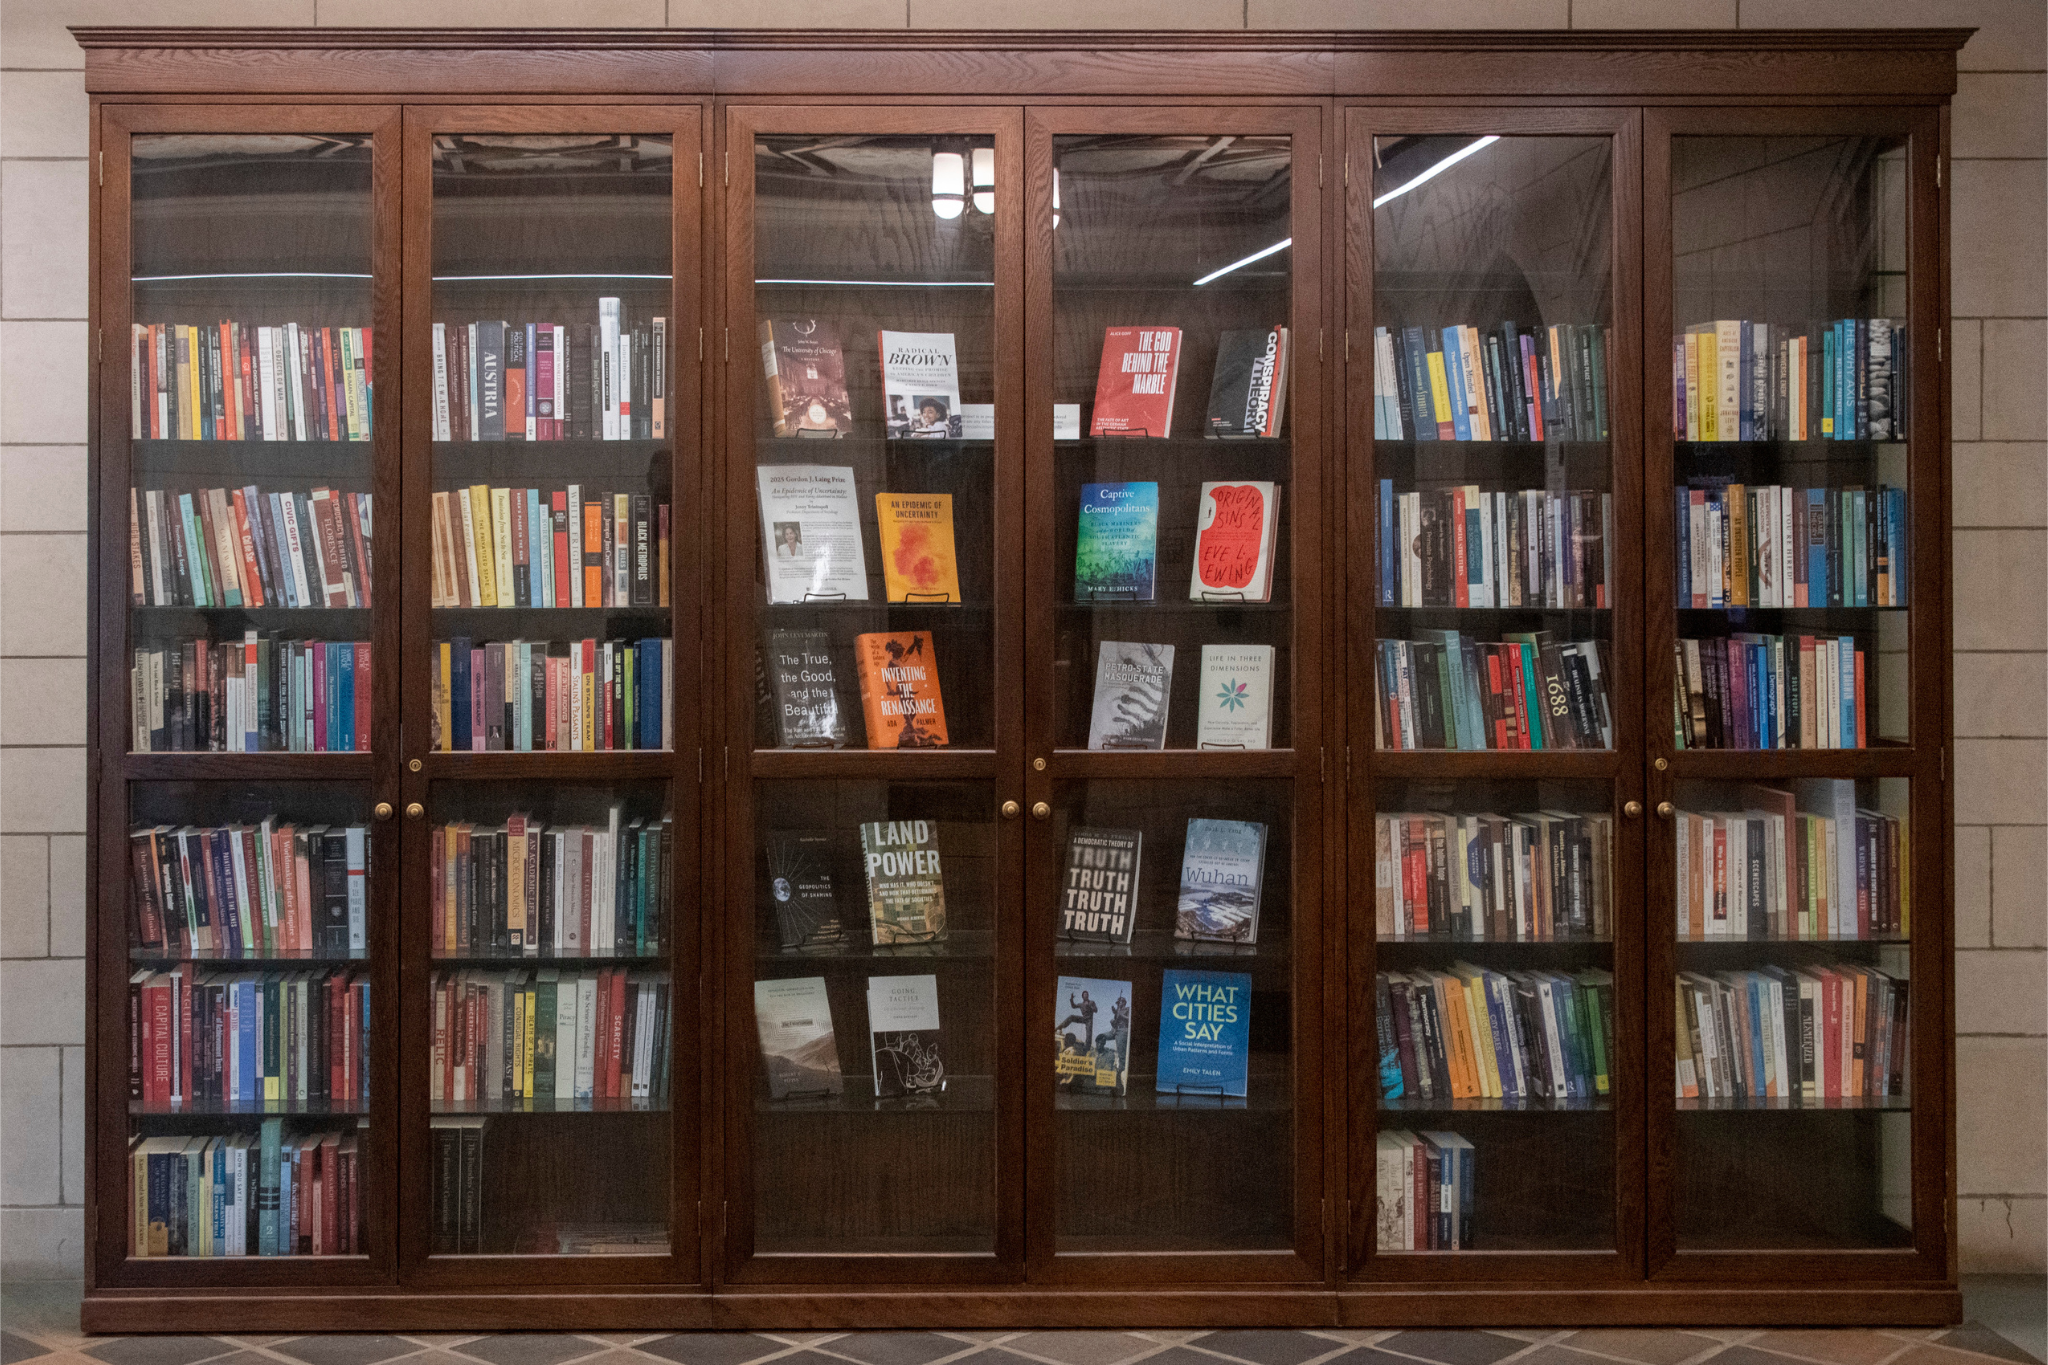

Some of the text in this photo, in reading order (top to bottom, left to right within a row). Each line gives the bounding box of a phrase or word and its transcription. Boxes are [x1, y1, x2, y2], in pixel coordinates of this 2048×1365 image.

[814, 347, 819, 355] of
[1138, 331, 1172, 352] THE GOD
[888, 353, 952, 366] BROWN
[1121, 353, 1169, 373] BEHIND THE
[277, 377, 283, 386] OF
[1255, 331, 1277, 432] CONSPIRACY
[1463, 352, 1475, 394] Open Minded
[484, 351, 497, 419] AUSTRIA
[1132, 374, 1166, 394] MARBLE
[891, 501, 941, 509] AN EPIDEMIC OF
[1100, 490, 1134, 501] Captive
[895, 510, 938, 519] UNCERTAINTY
[1084, 504, 1150, 516] Cosmopolitans
[1217, 510, 1245, 529] SINS
[284, 501, 299, 552] CIVIC GIFTS
[332, 499, 348, 569] DEMOCRACY REMIXED
[130, 522, 141, 569] HIGH STAKES
[175, 525, 184, 557] Provincializing
[324, 518, 338, 565] FLORENCE
[637, 521, 648, 580] BLACK METROPOLIS
[571, 532, 580, 572] FRIGHT
[1204, 544, 1245, 561] EVE L.
[1205, 558, 1254, 583] EWING
[1425, 558, 1433, 590] Psychology
[780, 653, 832, 665] The True,
[1105, 663, 1164, 674] PETRO-STATE
[137, 675, 145, 694] DAVIS
[781, 670, 836, 683] the Good,
[881, 666, 927, 682] INVENTING
[1104, 672, 1162, 684] MASQUERADE
[790, 688, 828, 699] and the
[898, 683, 913, 698] THE
[1545, 674, 1568, 717] 1688
[572, 676, 580, 740] STALIN'S PEASANTS
[881, 698, 937, 715] RENAISSANCE
[916, 718, 936, 726] PALMER
[874, 820, 928, 846] LAND
[1078, 838, 1108, 846] DEMOCRATIC
[529, 839, 536, 850] AN
[284, 840, 292, 889] Worldmaking
[868, 850, 941, 877] POWER
[1072, 846, 1132, 870] TRUTH
[511, 841, 520, 917] MICROECONOMICS
[1070, 868, 1129, 892] TRUTH
[1186, 866, 1249, 886] Wuhan
[1752, 859, 1760, 907] SCENESCAPES
[1067, 889, 1127, 914] TRUTH
[287, 910, 296, 936] Empire
[1064, 910, 1125, 935] TRUTH
[1175, 983, 1239, 1003] WHAT
[1173, 1002, 1238, 1023] CITIES
[1420, 994, 1432, 1037] Pharmocracy
[612, 1015, 622, 1059] SCARCITY
[1184, 1022, 1224, 1041] SAY
[1489, 1014, 1501, 1051] CITY RULES
[1801, 1016, 1813, 1064] MESMERIZED
[155, 1005, 169, 1082] CAPITAL CULTURE
[435, 1029, 445, 1065] RELIC
[1060, 1064, 1093, 1073] Paradise
[1061, 1057, 1093, 1066] Soldier's
[1183, 1067, 1199, 1075] EMILY
